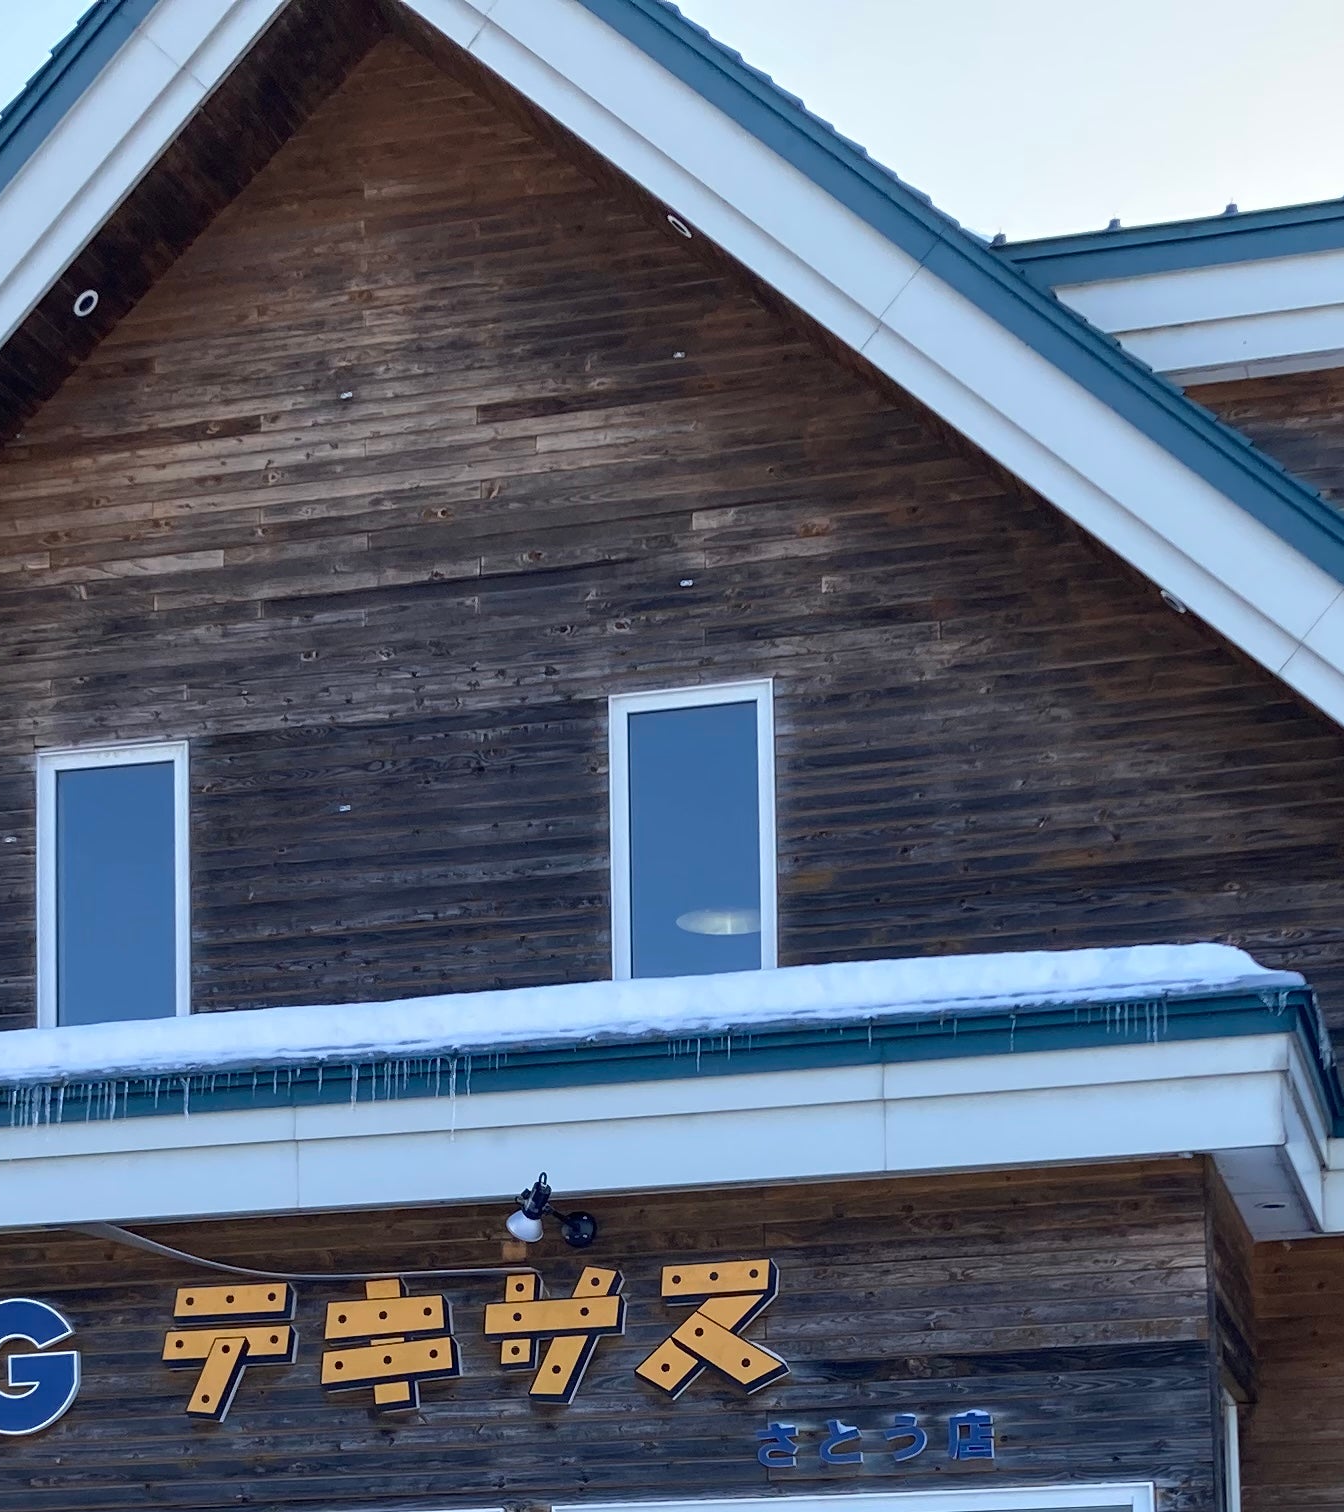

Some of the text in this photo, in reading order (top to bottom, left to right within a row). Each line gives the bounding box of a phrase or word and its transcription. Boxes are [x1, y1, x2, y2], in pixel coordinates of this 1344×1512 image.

[161, 1257, 792, 1424] テキサス
[756, 1408, 998, 1469] さとう店
